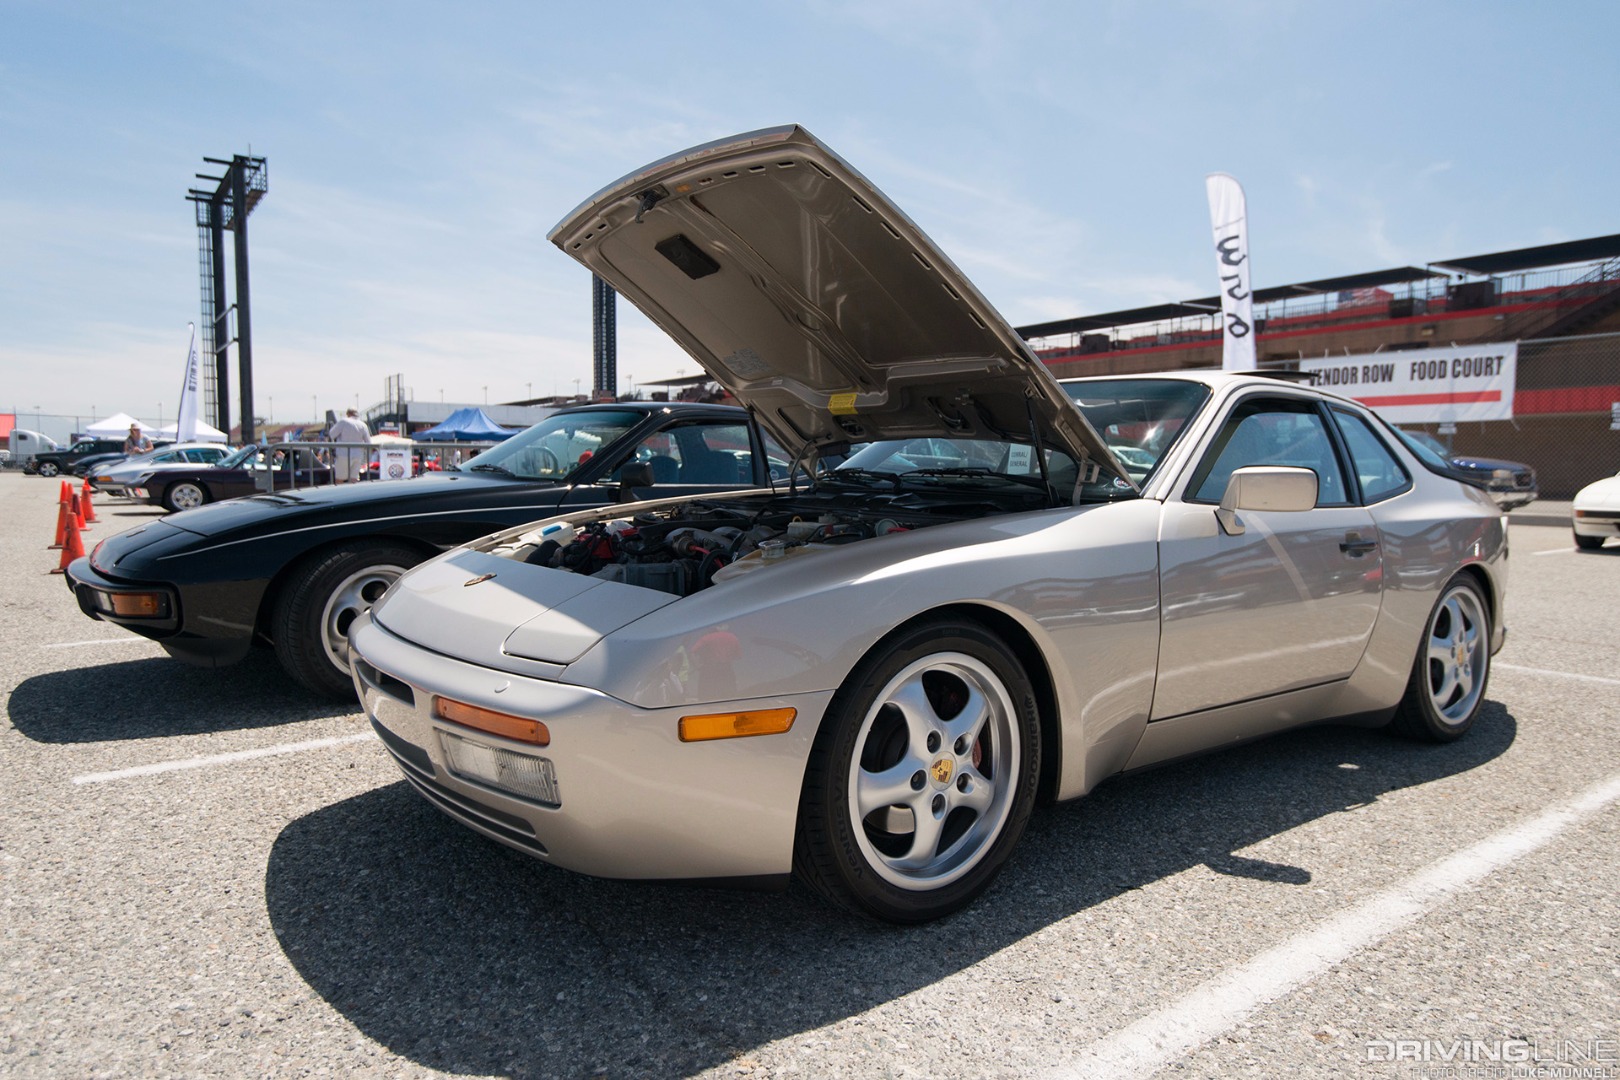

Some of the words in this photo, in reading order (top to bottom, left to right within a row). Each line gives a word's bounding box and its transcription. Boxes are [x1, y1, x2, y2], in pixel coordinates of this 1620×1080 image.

[1362, 363, 1395, 384] ROW
[1410, 360, 1447, 381] FOOD
[1452, 356, 1504, 378] COURT
